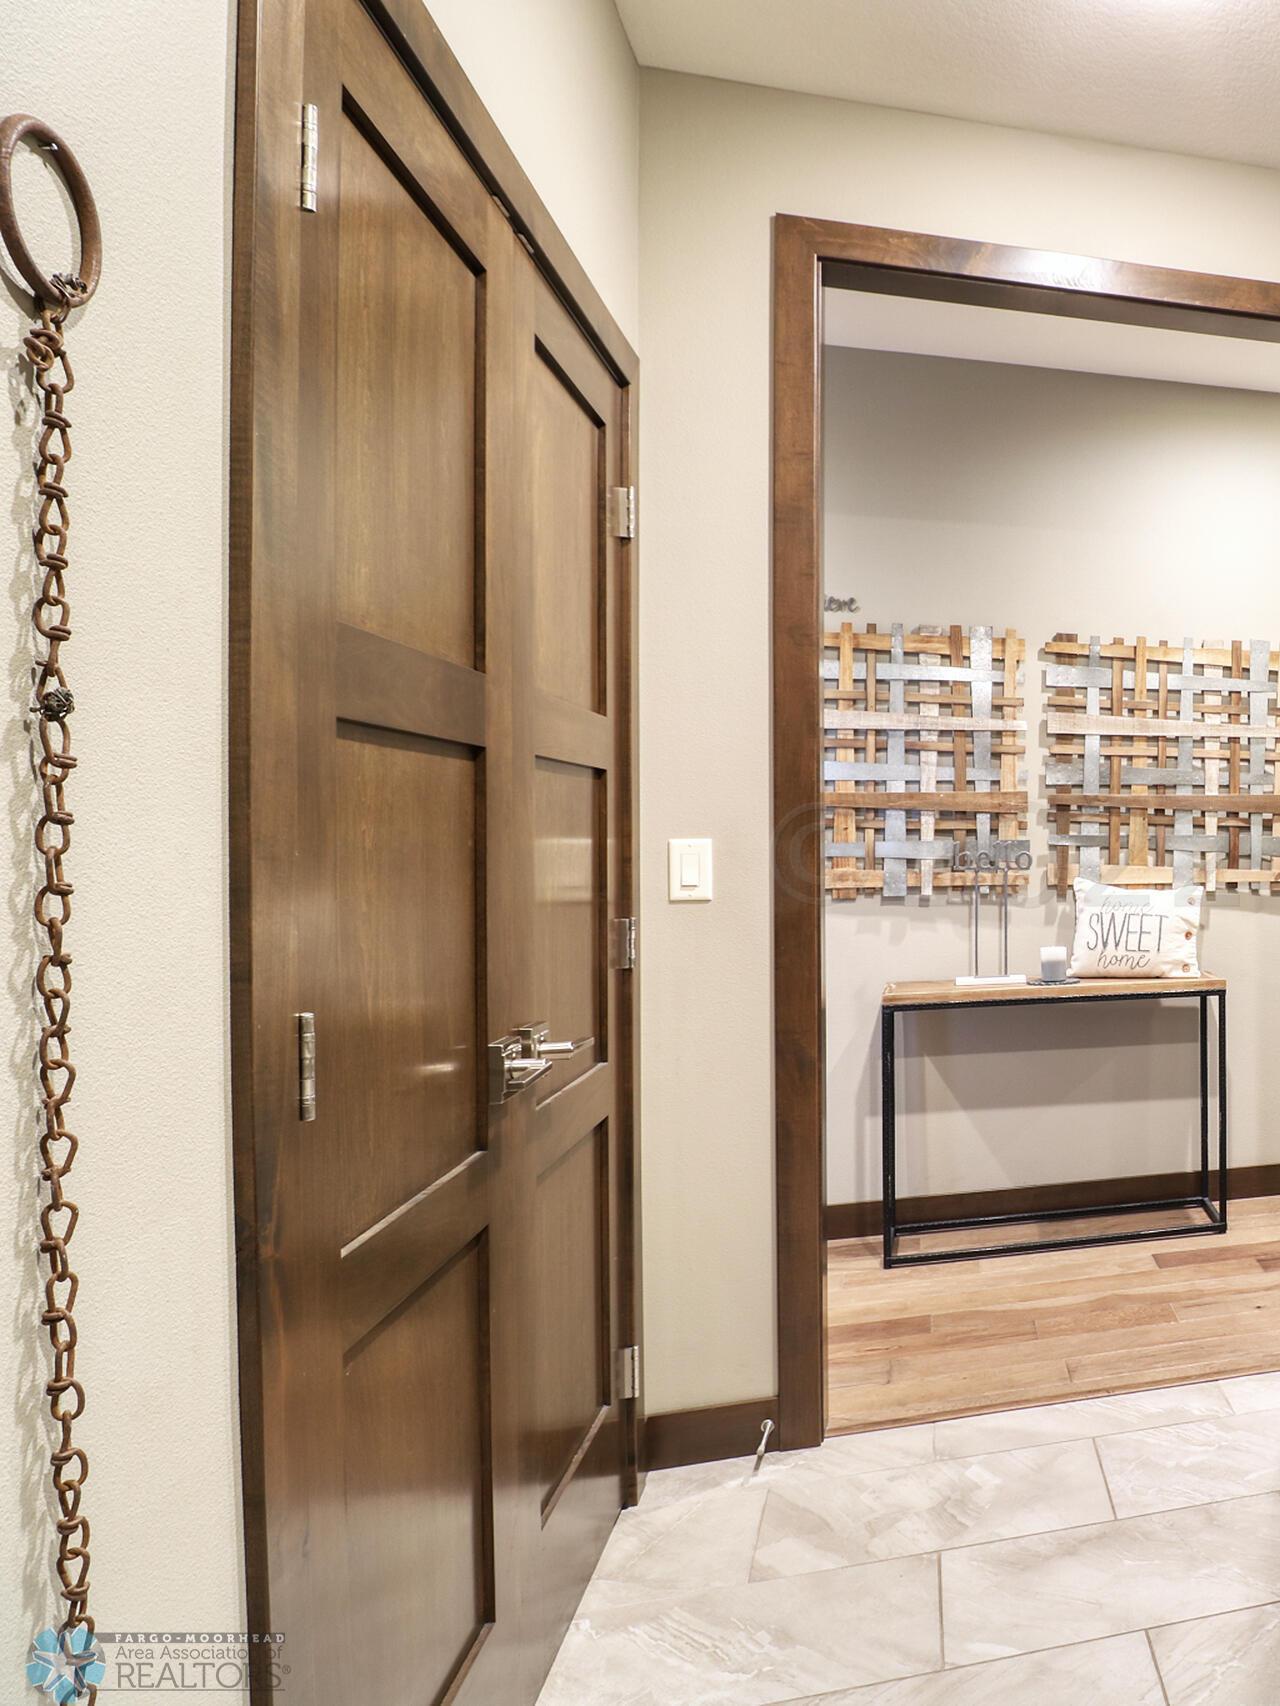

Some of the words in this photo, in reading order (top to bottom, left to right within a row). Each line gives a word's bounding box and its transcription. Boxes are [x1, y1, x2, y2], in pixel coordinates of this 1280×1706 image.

[952, 840, 1033, 873] hello
[1100, 896, 1155, 915] home
[1086, 911, 1169, 953] SWEET
[1097, 952, 1151, 971] home
